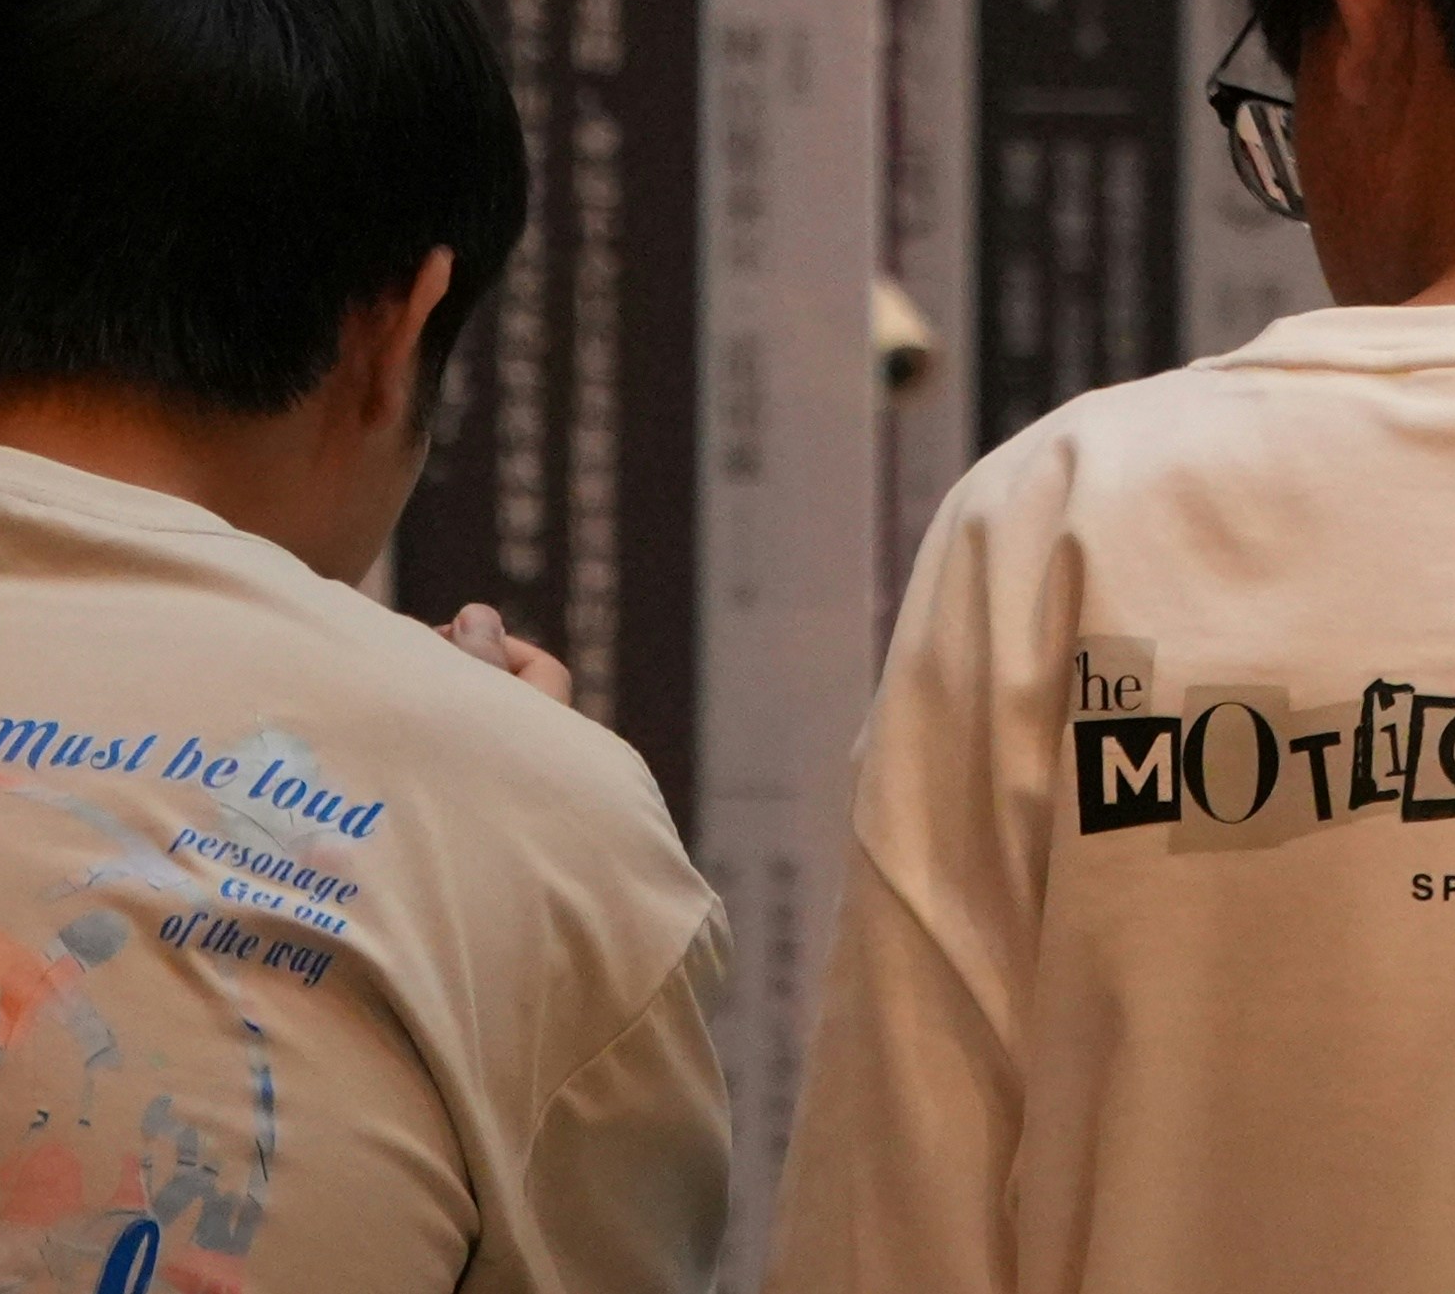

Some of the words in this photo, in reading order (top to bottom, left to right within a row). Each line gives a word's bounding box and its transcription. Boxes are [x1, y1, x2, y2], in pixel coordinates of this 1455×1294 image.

[161, 736, 239, 789] be
[248, 758, 385, 839] loud
[168, 827, 360, 906] personage
[158, 910, 209, 951] of
[201, 916, 262, 962] the
[262, 937, 337, 989] way
